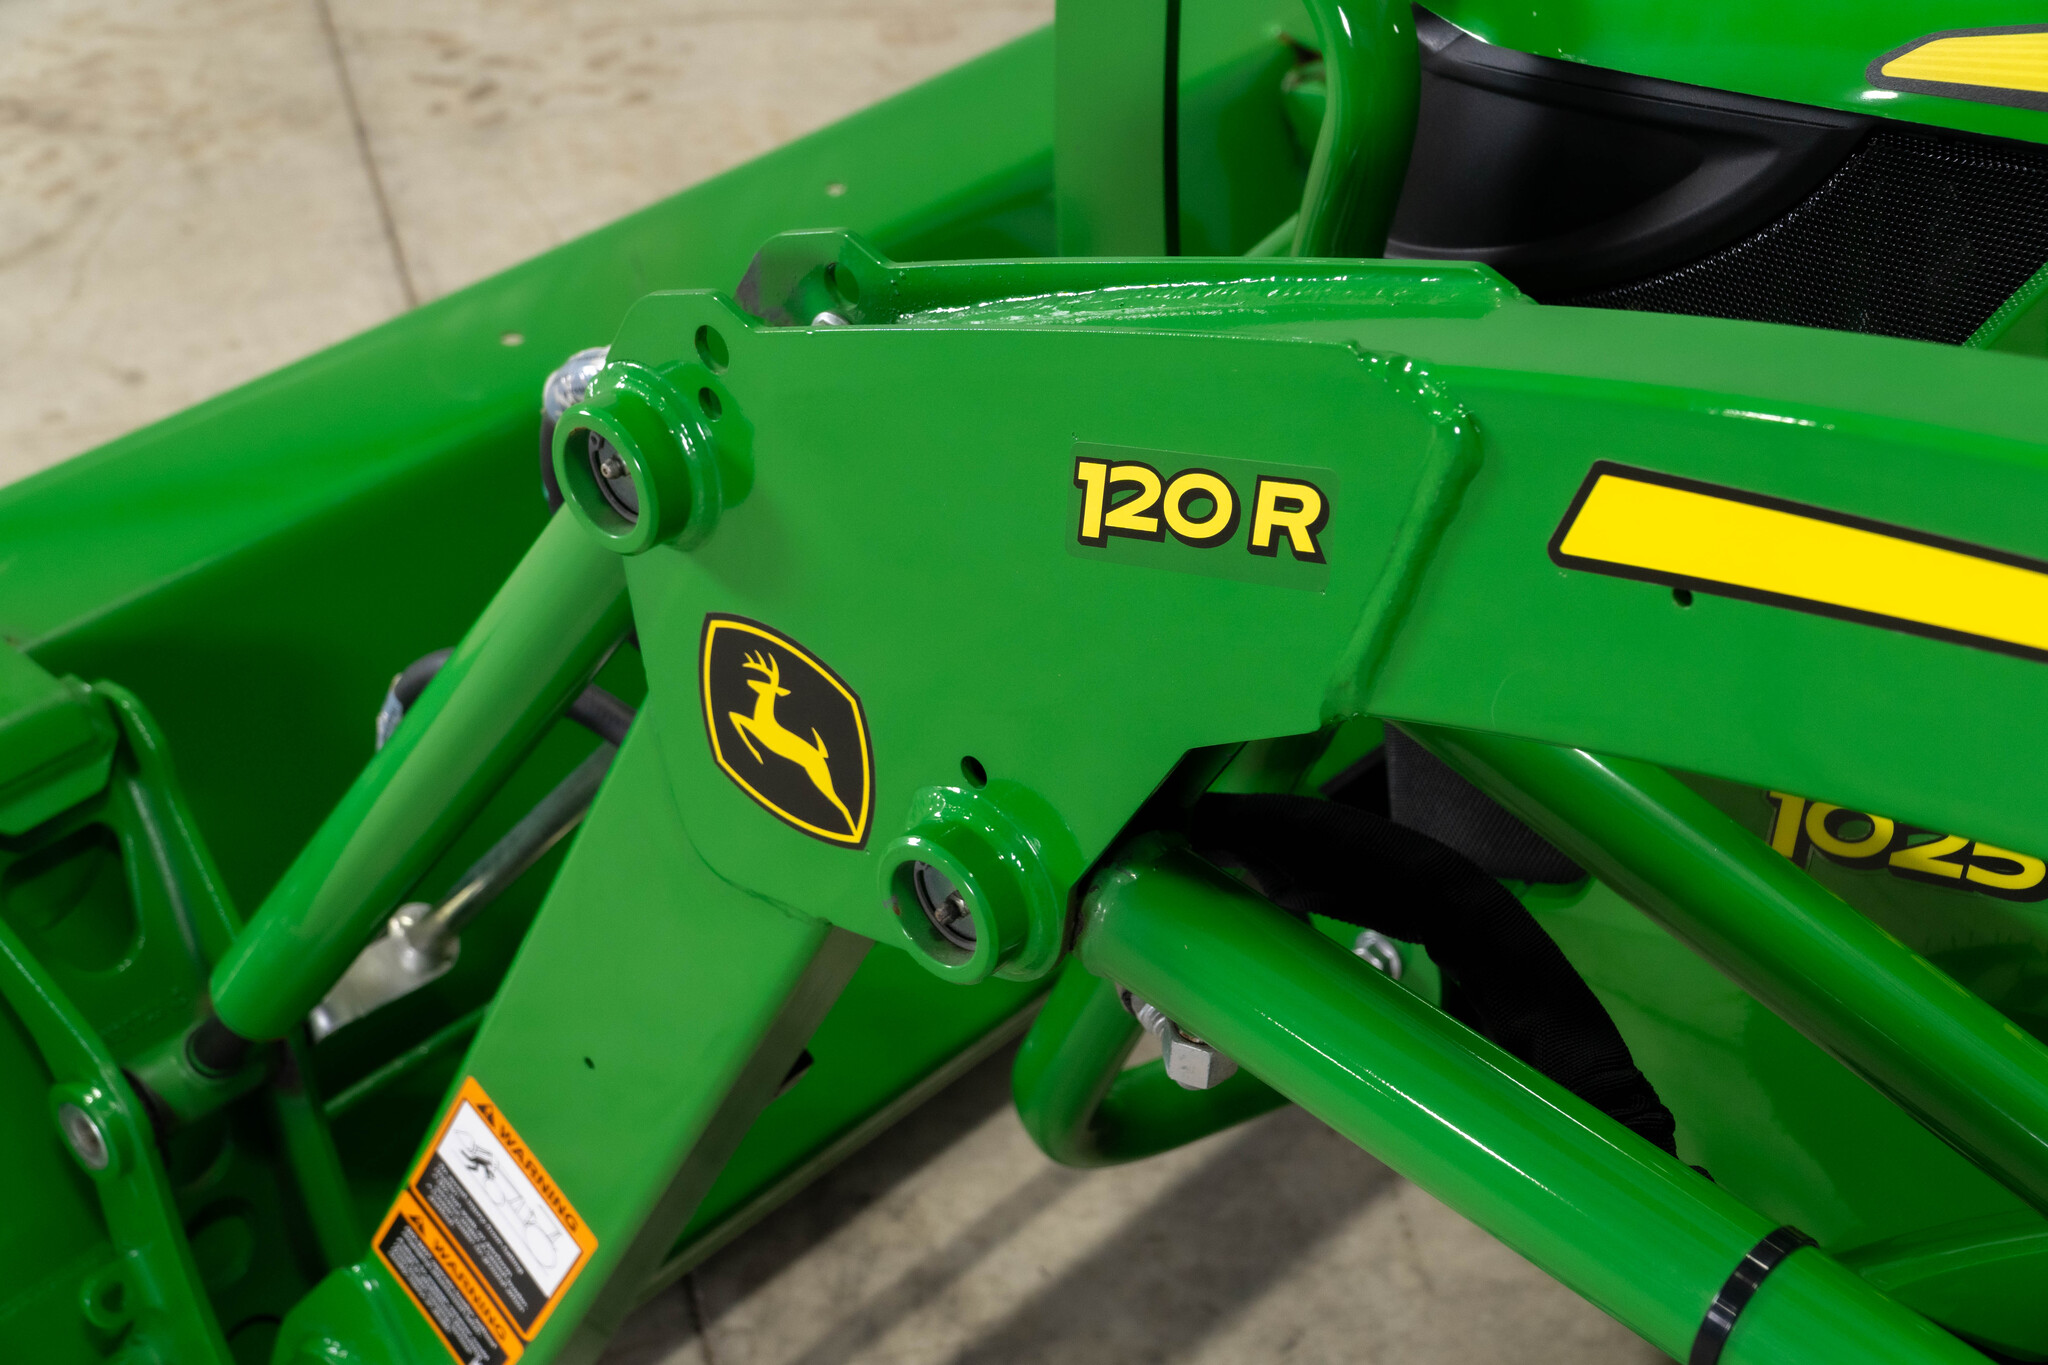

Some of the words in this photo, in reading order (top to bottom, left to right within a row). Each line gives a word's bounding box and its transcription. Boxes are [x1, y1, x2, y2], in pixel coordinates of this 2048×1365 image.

[1075, 458, 1239, 546] 120
[1248, 475, 1328, 562] R
[499, 1125, 579, 1233] WARNING
[433, 1240, 507, 1342] WARNING
